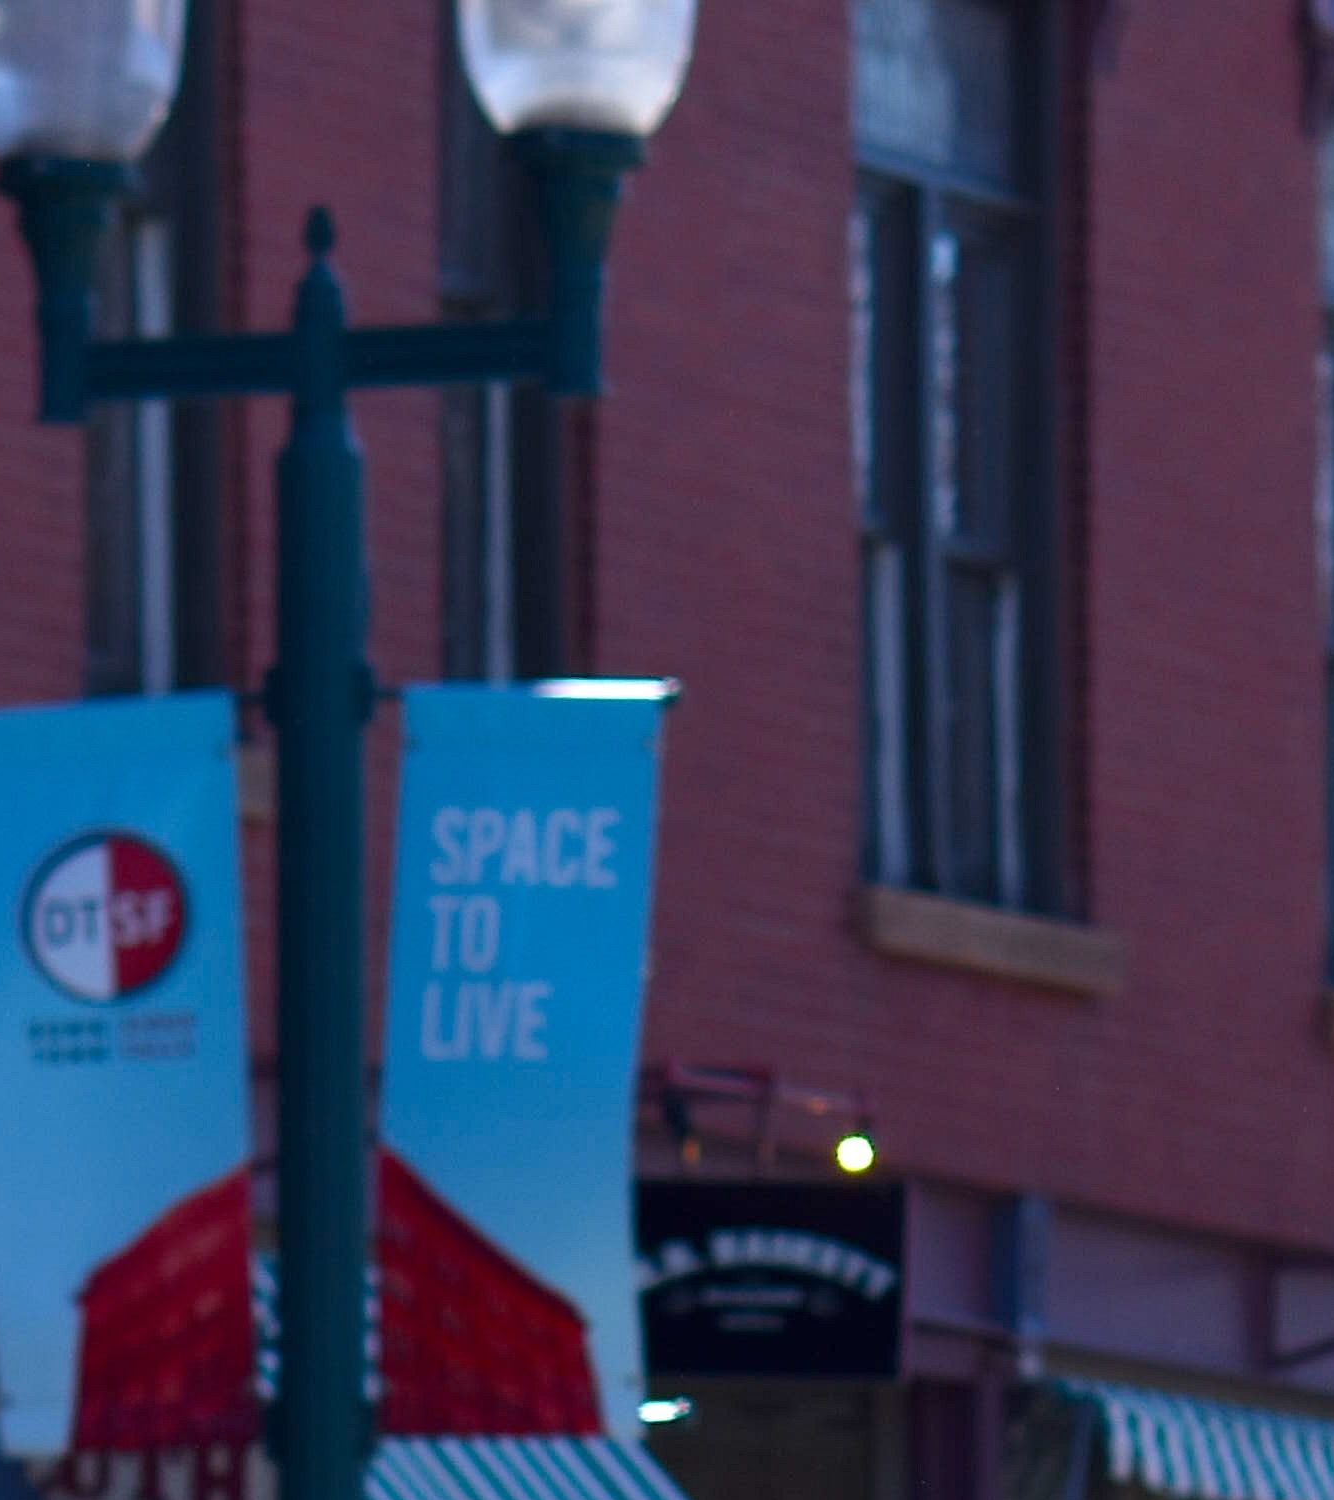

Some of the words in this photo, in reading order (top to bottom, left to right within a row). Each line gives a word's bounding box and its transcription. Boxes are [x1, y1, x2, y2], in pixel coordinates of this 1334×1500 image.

[430, 806, 620, 887] SPACE
[429, 894, 499, 972] TO
[421, 980, 553, 1060] LIVE
